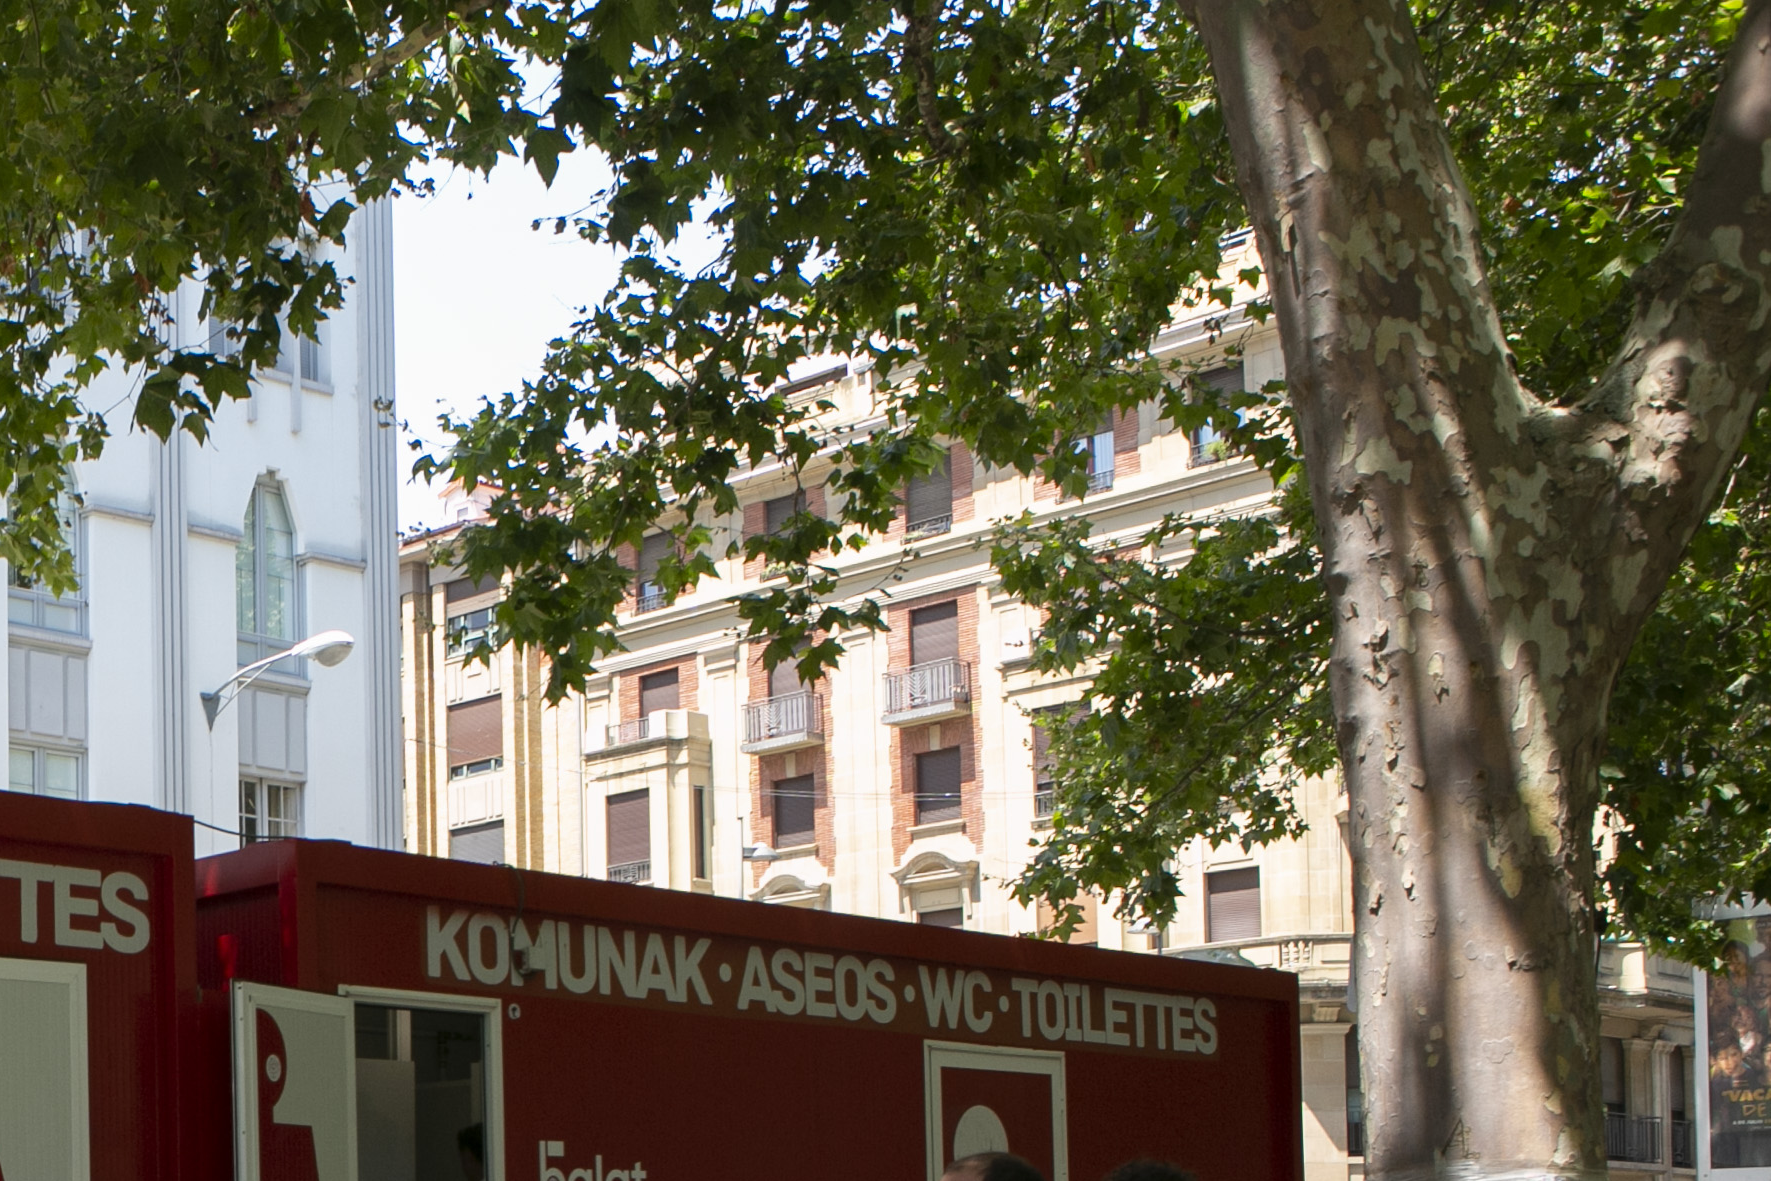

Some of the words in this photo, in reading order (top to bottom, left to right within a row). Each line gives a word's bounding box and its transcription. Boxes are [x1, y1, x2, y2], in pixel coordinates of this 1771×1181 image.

[426, 904, 714, 1006] KOMUNAK
[737, 945, 897, 1024] ASEOS
[917, 964, 994, 1034] WC
[1011, 977, 1218, 1055] TOILETTES
[1742, 1103, 1768, 1118] DE
